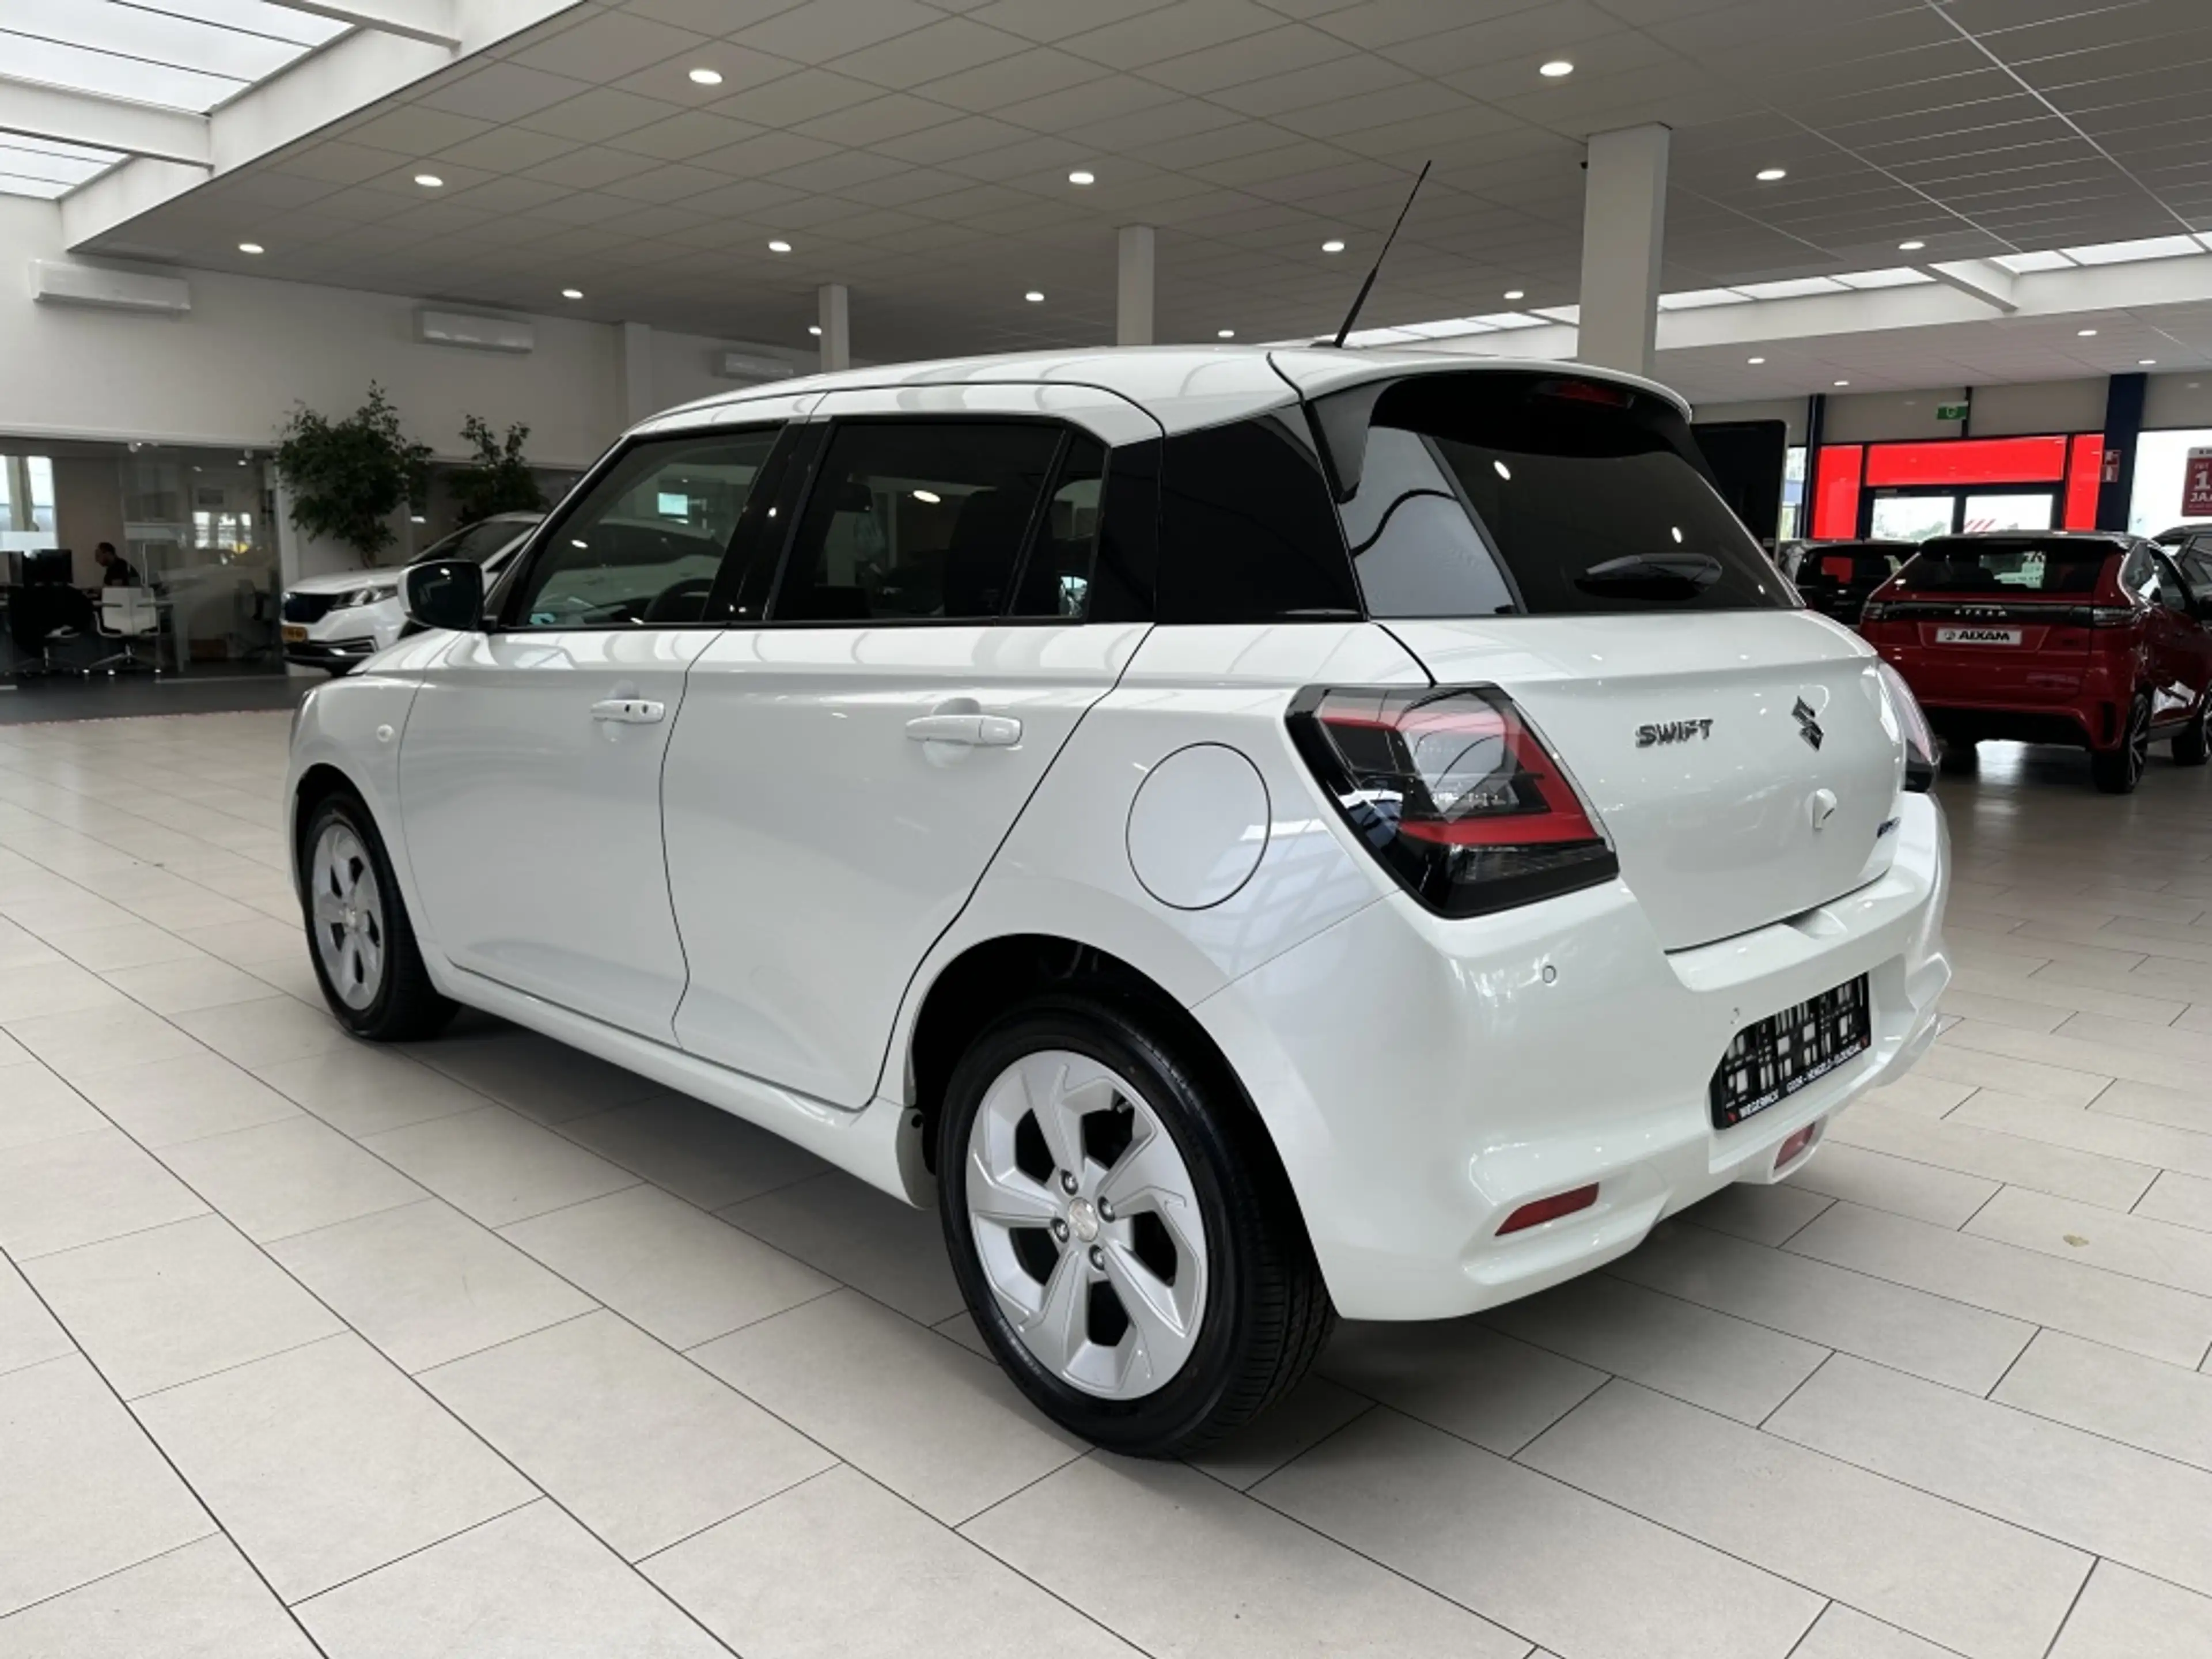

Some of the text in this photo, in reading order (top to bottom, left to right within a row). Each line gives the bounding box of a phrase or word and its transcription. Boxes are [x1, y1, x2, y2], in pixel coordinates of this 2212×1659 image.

[2194, 470, 2210, 489] 1
[2190, 492, 2212, 502] JA
[1959, 630, 2010, 641] AIXAM
[1635, 718, 1714, 748] SWIFT
